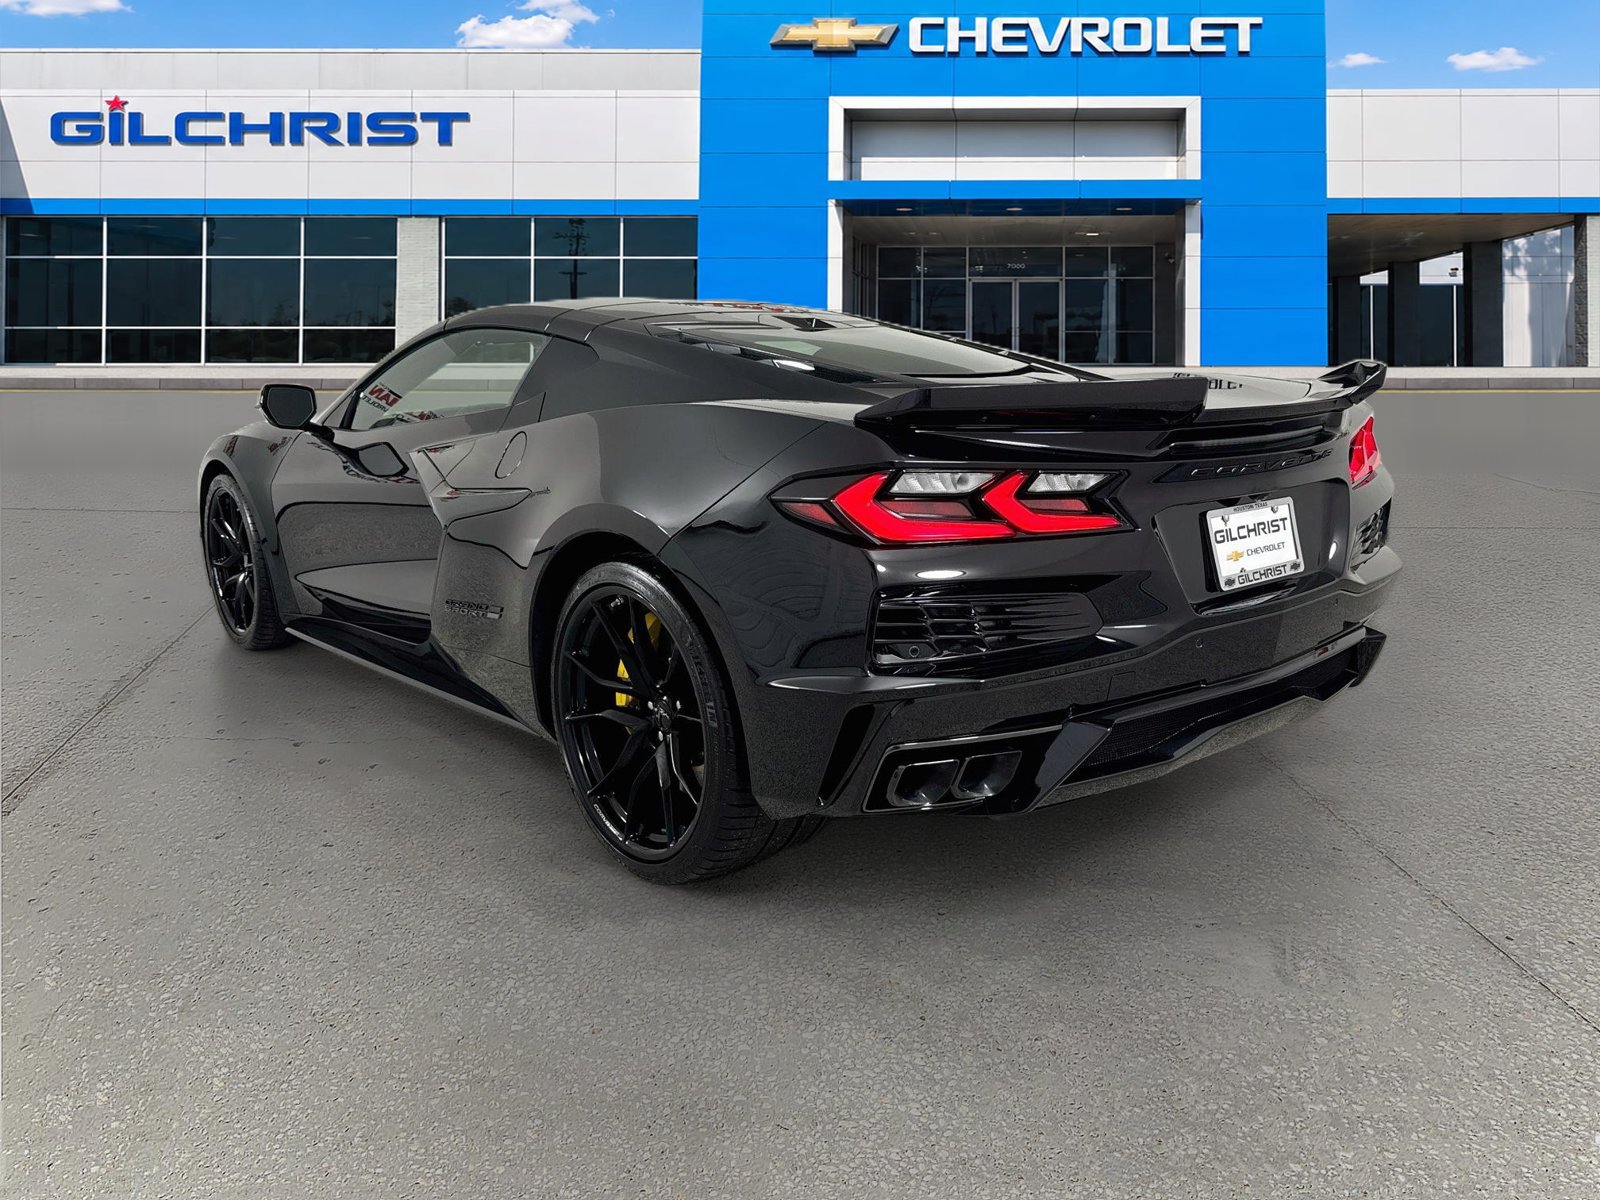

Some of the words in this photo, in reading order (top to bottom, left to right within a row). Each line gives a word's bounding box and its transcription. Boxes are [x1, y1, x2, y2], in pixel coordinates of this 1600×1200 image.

[909, 17, 1263, 53] CHEVROLET
[50, 111, 470, 146] GILCHRIST
[1190, 449, 1333, 475] CORVETTE
[1255, 501, 1268, 509] TEXAS
[1214, 517, 1288, 545] GILCHRIST
[1246, 541, 1285, 557] CHEVROLET
[1237, 564, 1287, 585] GILCHRIST
